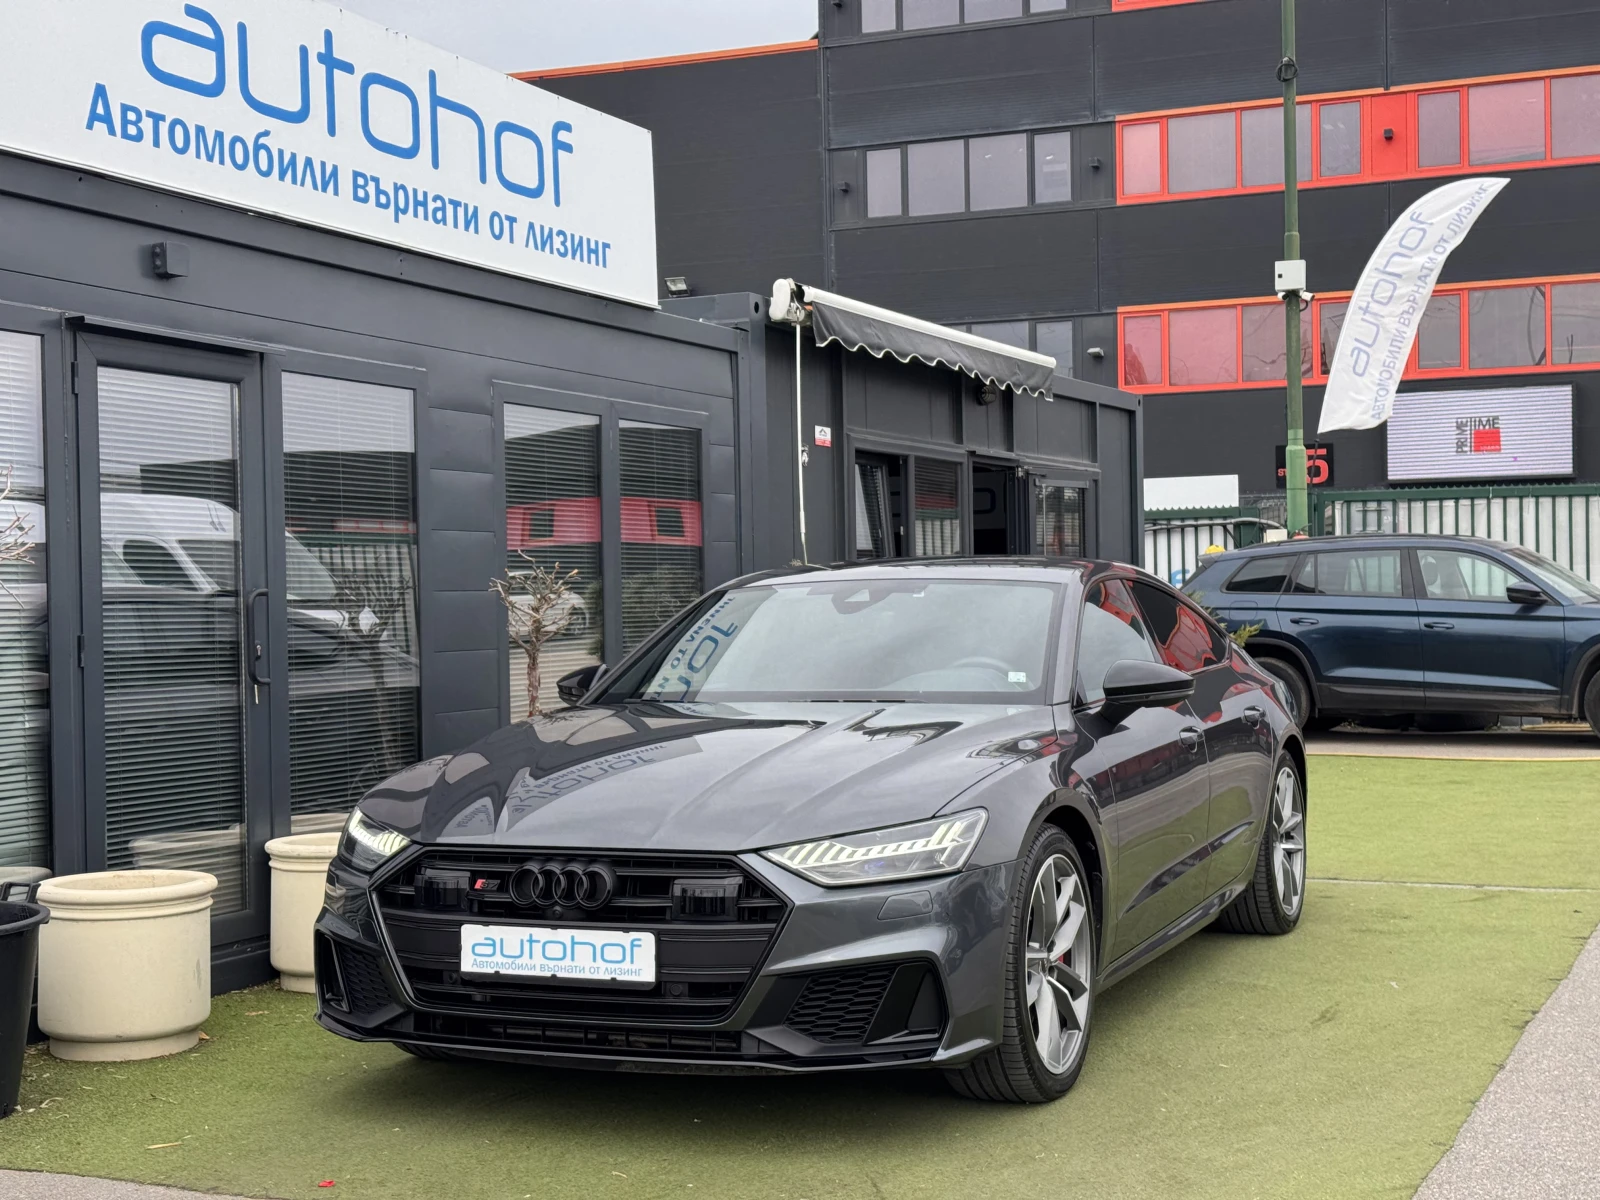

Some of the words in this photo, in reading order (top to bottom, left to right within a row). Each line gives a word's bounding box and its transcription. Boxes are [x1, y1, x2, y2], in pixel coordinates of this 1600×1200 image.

[140, 3, 574, 207] autohof
[85, 82, 340, 196] Автомобили
[351, 170, 481, 235] върнати
[488, 210, 518, 245] от
[524, 227, 611, 268] лизинг
[1350, 211, 1434, 378] autohof
[1432, 234, 1451, 256] ОТ
[471, 933, 642, 965] autohof
[471, 958, 537, 972] Автомобили
[539, 963, 586, 975] върнати
[589, 966, 601, 976] от
[603, 966, 643, 977] лизинг
